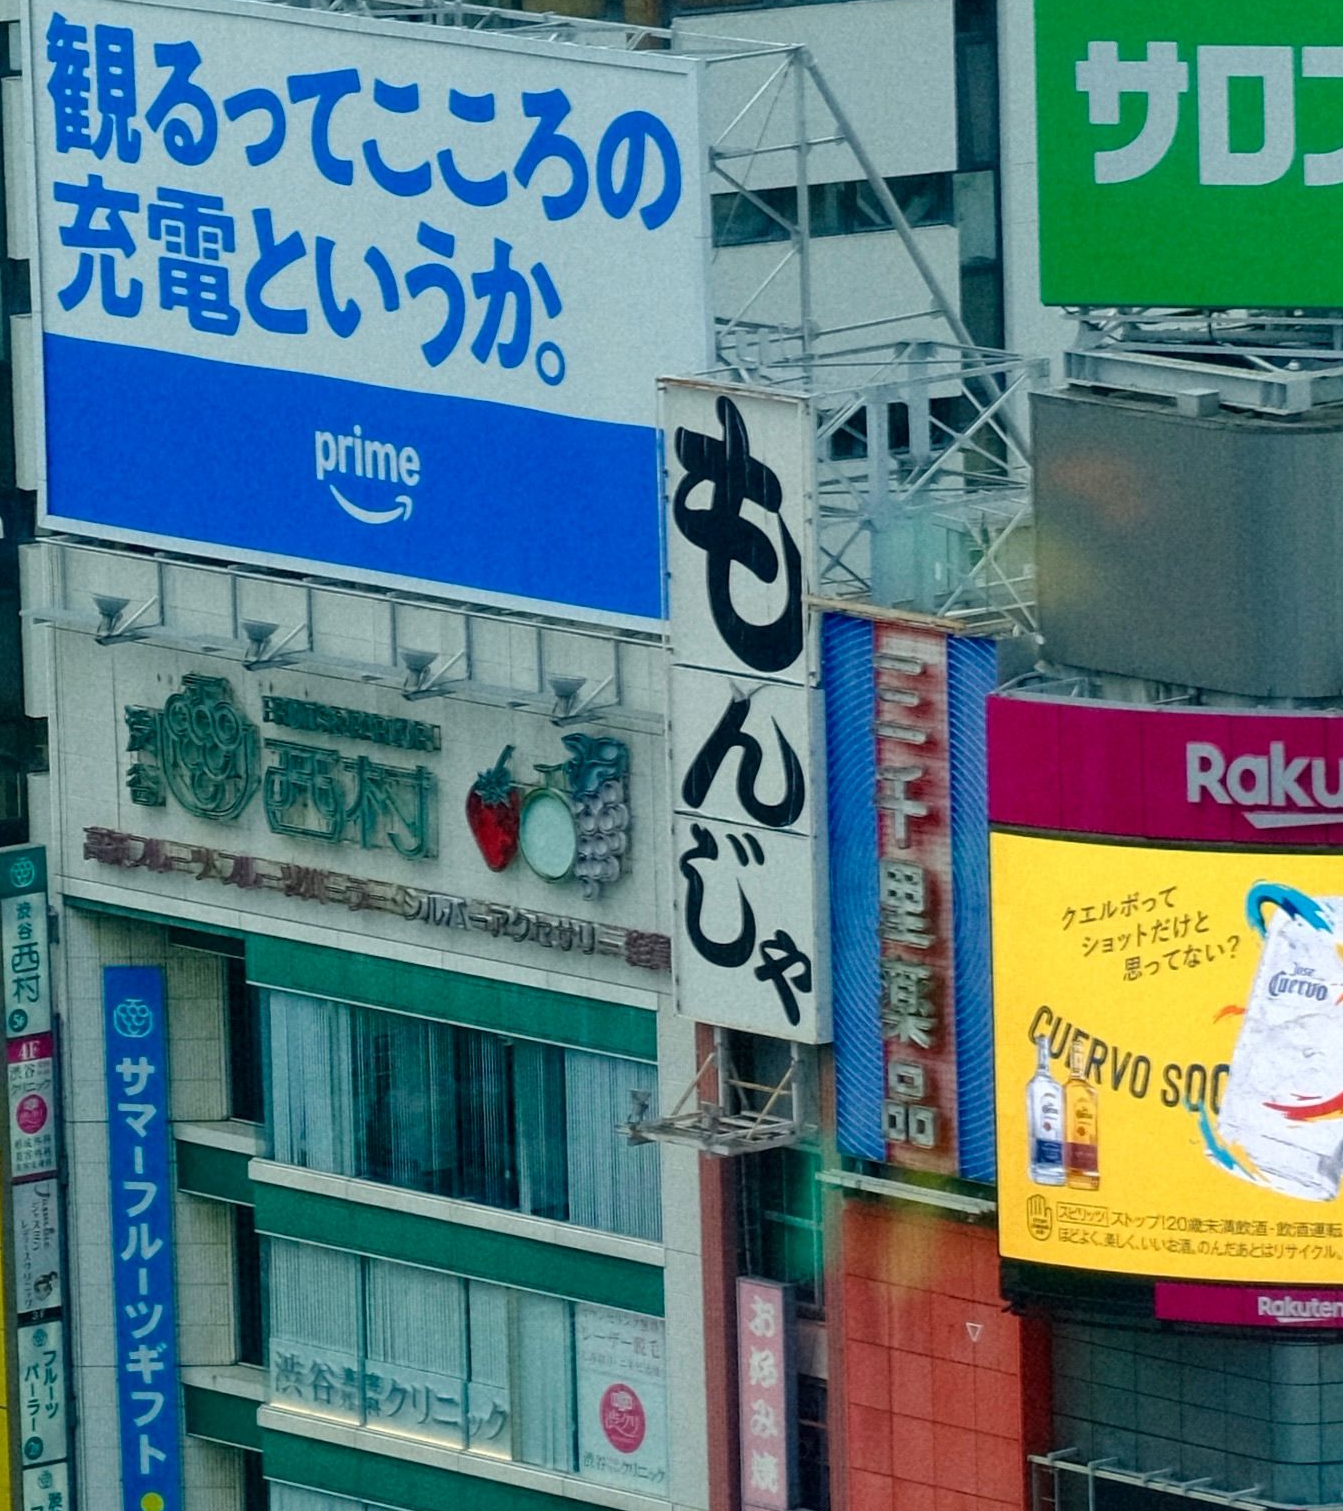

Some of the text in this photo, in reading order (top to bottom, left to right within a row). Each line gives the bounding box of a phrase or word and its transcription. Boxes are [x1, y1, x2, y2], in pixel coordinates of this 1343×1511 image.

[46, 11, 682, 231] 観るってこころの
[53, 173, 565, 386] 充電というか。
[314, 424, 421, 488] prime
[674, 395, 813, 1026] もんじゃ
[264, 738, 439, 859] 西村
[874, 651, 940, 1149] 三千里薬品
[1060, 885, 1178, 931] クエルボって
[1081, 911, 1210, 957] ショットだけと
[11, 942, 41, 1003] 西村
[1123, 934, 1239, 983] 思ってない？
[1268, 969, 1330, 1005] Cuervo
[1028, 1006, 1151, 1099] CUERVO
[1058, 1205, 1106, 1224] スピリッツ
[115, 1056, 167, 1475] サマーフルーツギフト
[24, 1362, 40, 1431] パーラー
[43, 1350, 59, 1419] フルーツ
[275, 1350, 336, 1405] 渋谷
[384, 1378, 510, 1441] クリニック
[749, 1294, 779, 1494] お好み焼
